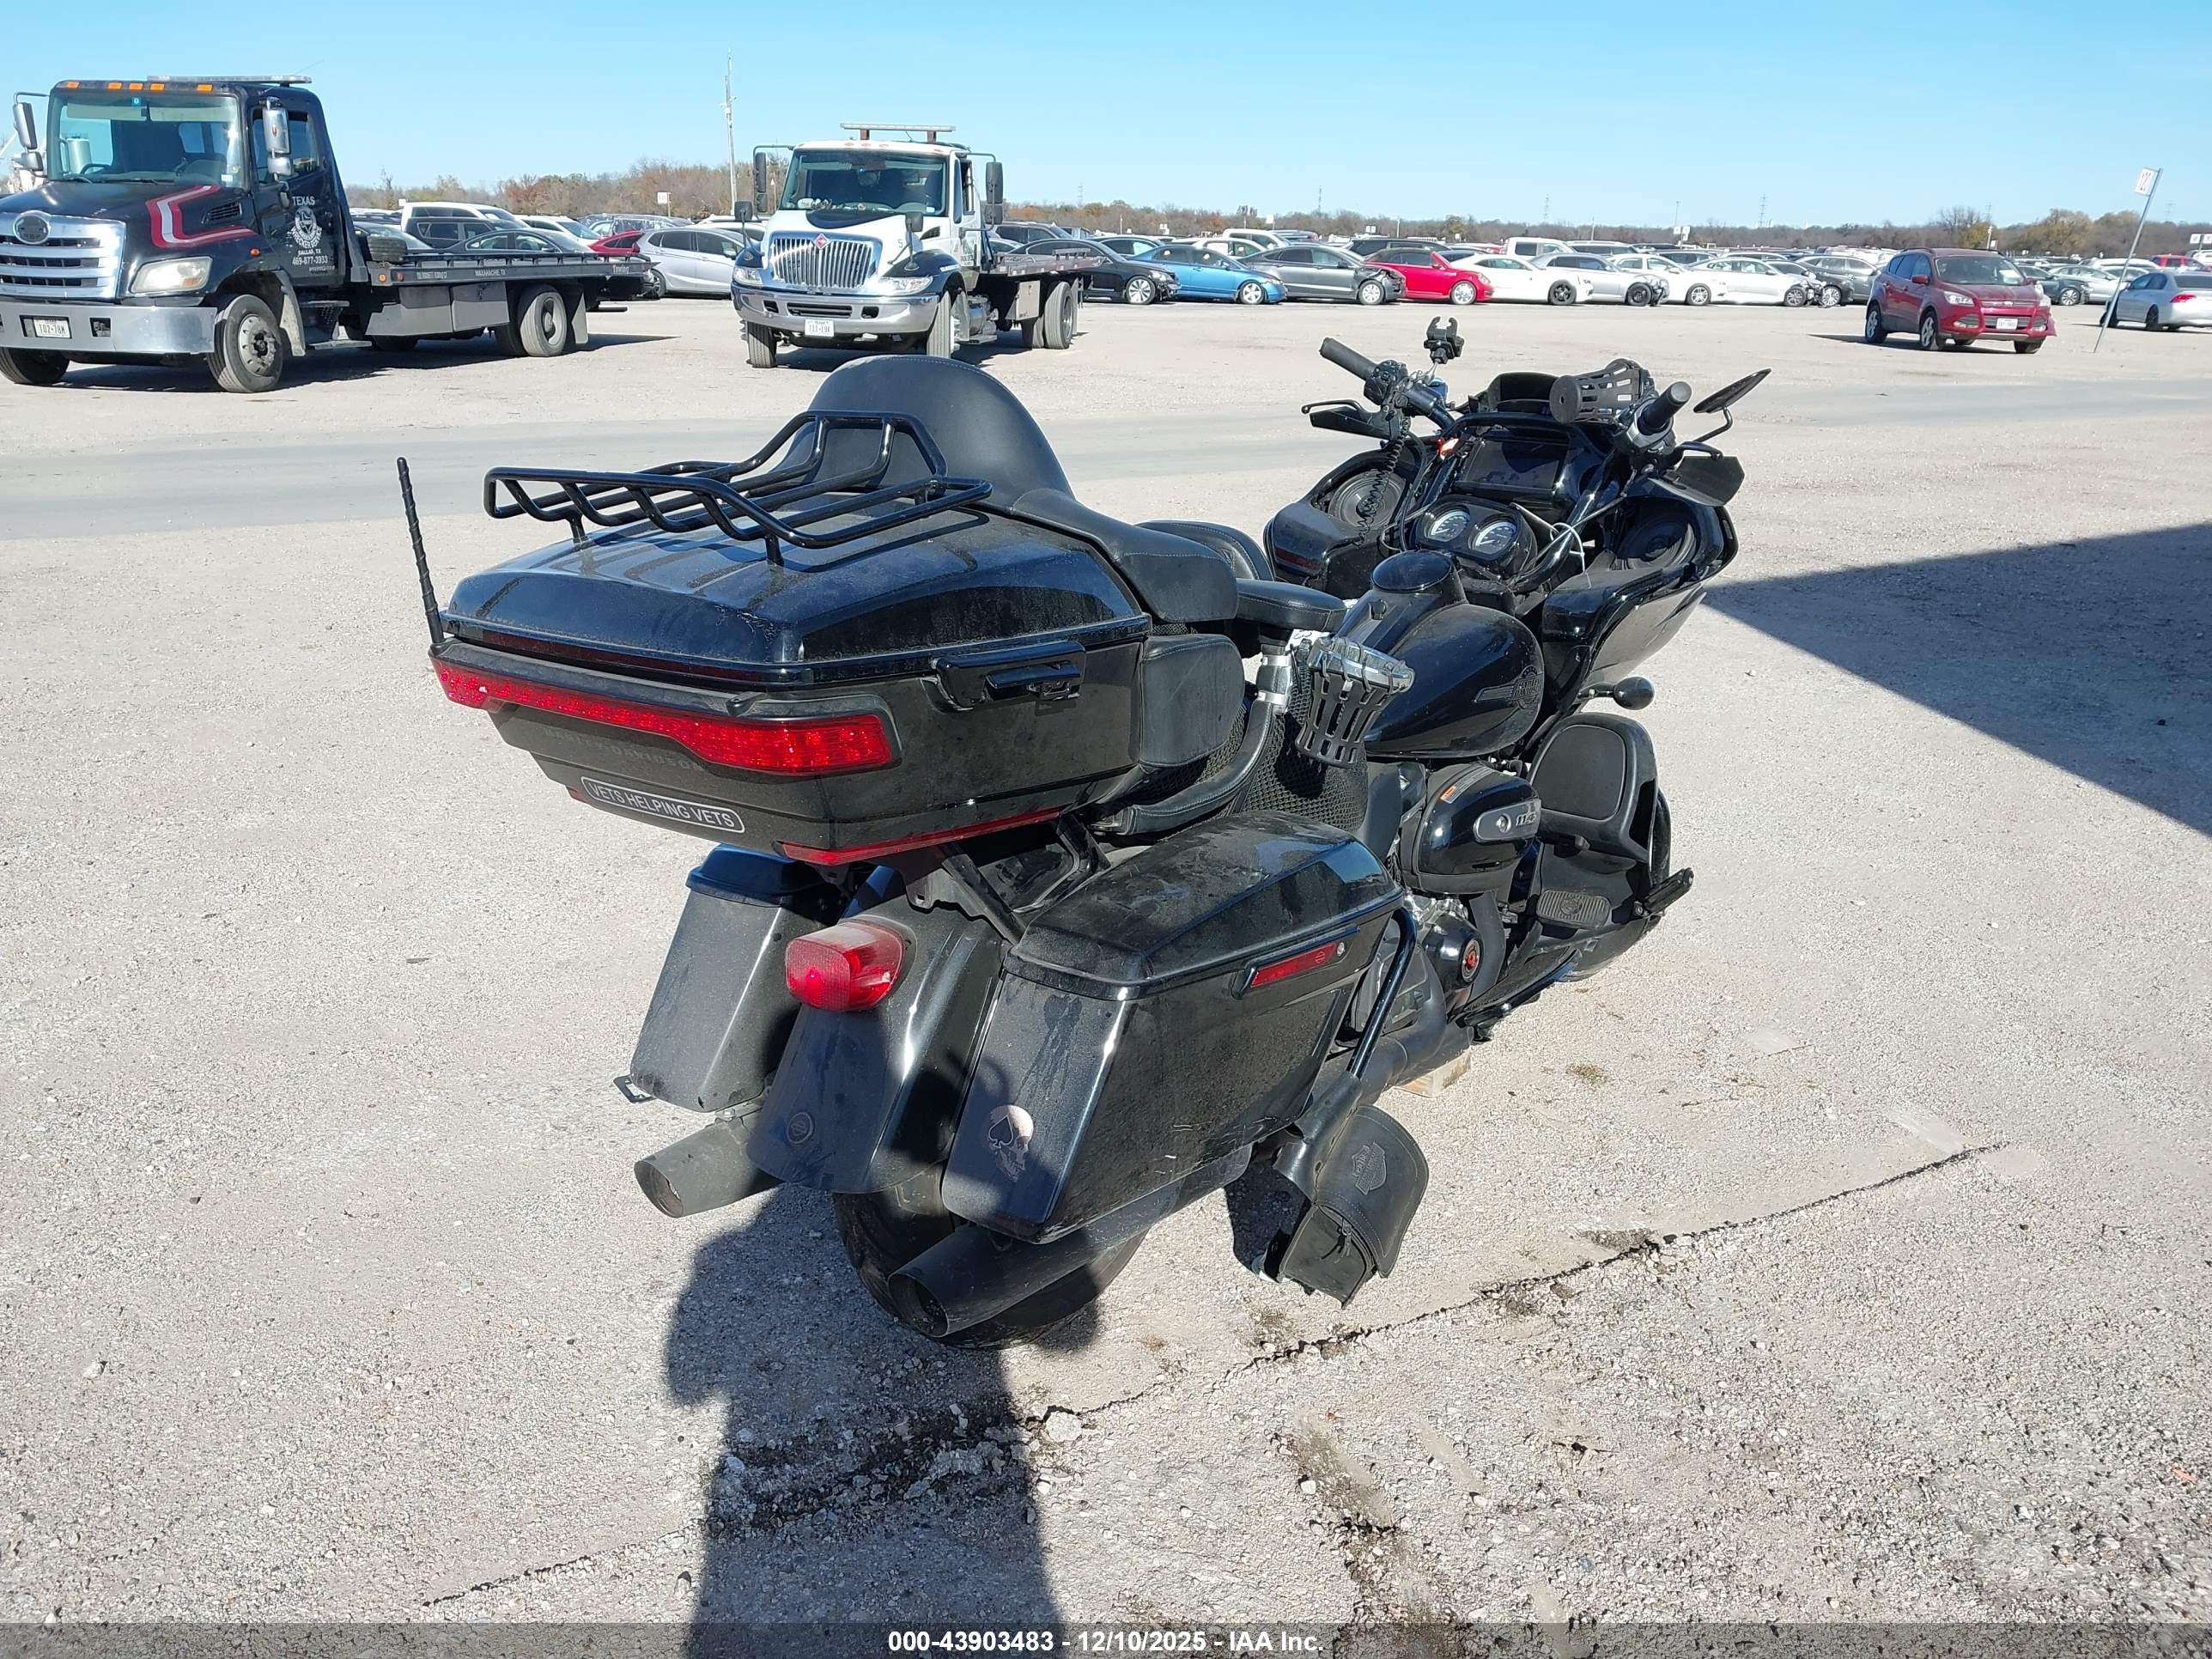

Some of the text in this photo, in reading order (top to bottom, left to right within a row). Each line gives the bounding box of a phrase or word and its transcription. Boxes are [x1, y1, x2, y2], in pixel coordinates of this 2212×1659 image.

[292, 196, 315, 205] TEXAS
[588, 782, 735, 828] VETS HELPING VETS
